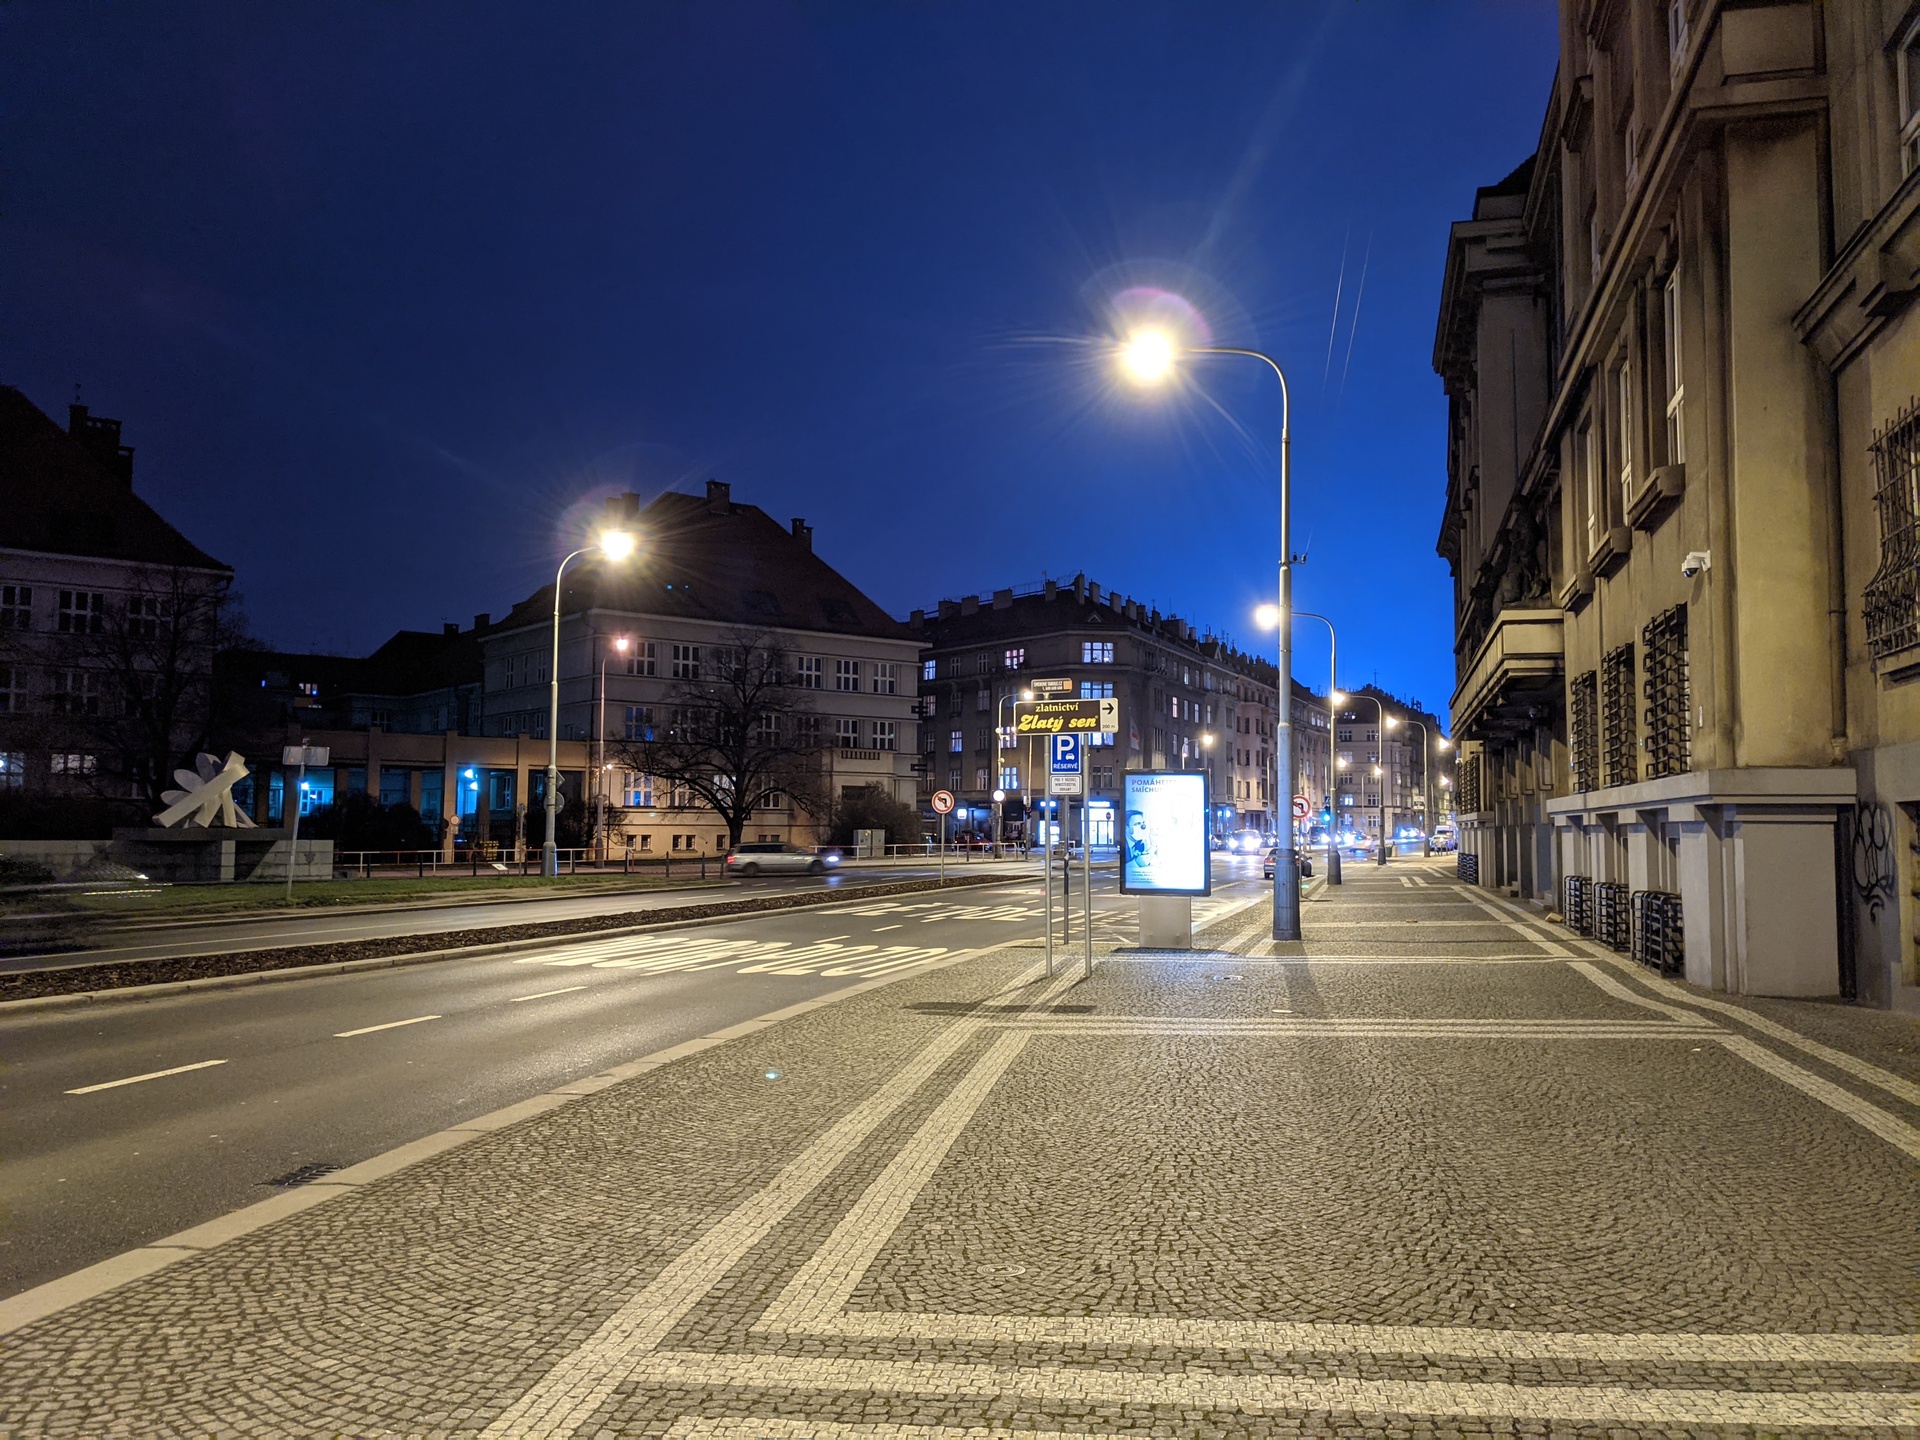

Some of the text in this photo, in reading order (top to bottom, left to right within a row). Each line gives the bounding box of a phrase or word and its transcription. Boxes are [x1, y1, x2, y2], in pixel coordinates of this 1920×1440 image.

[1035, 702, 1079, 712] zlatnictví
[1018, 714, 1097, 732] Zlatý sen
[1056, 735, 1075, 760] P
